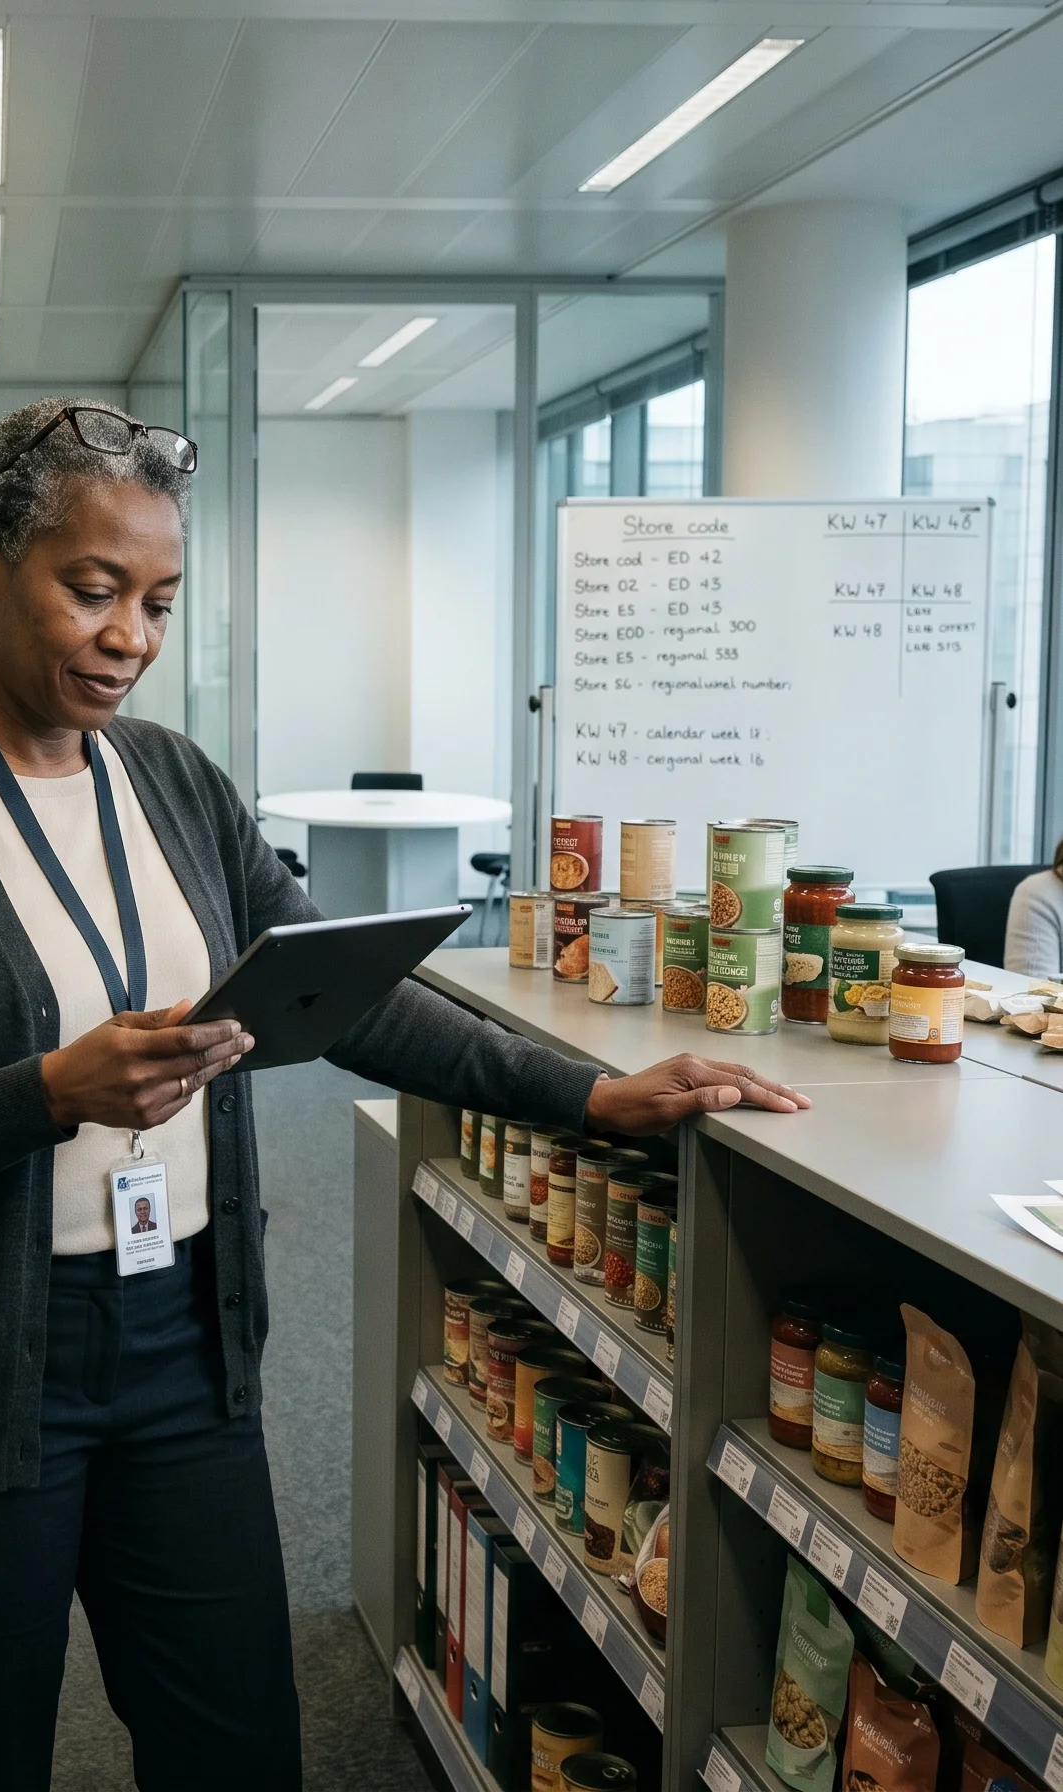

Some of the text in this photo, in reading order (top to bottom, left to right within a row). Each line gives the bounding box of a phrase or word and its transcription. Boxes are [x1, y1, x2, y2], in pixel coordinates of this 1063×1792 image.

[623, 514, 729, 536] Store code
[827, 513, 887, 530] KW 47
[912, 513, 941, 530] KW
[574, 551, 609, 568] Store
[668, 550, 690, 565] ED
[700, 549, 722, 565] 42
[574, 579, 609, 594] Store
[668, 577, 690, 591] ED
[834, 582, 886, 597] KW 47
[912, 582, 962, 598] KW 48
[574, 603, 609, 618] Store
[668, 602, 689, 616] ED
[574, 628, 609, 642] Store
[663, 621, 720, 641] regional
[729, 620, 756, 633] 300
[833, 622, 882, 638] KW 48
[574, 652, 608, 667] Store
[656, 648, 708, 667] regional
[574, 678, 608, 692] Store
[576, 722, 600, 739] KW
[608, 722, 627, 738] 47
[646, 725, 705, 740] calendar
[711, 725, 741, 740] week
[576, 750, 600, 766] KW
[608, 750, 627, 766] 48
[710, 753, 742, 767] week
